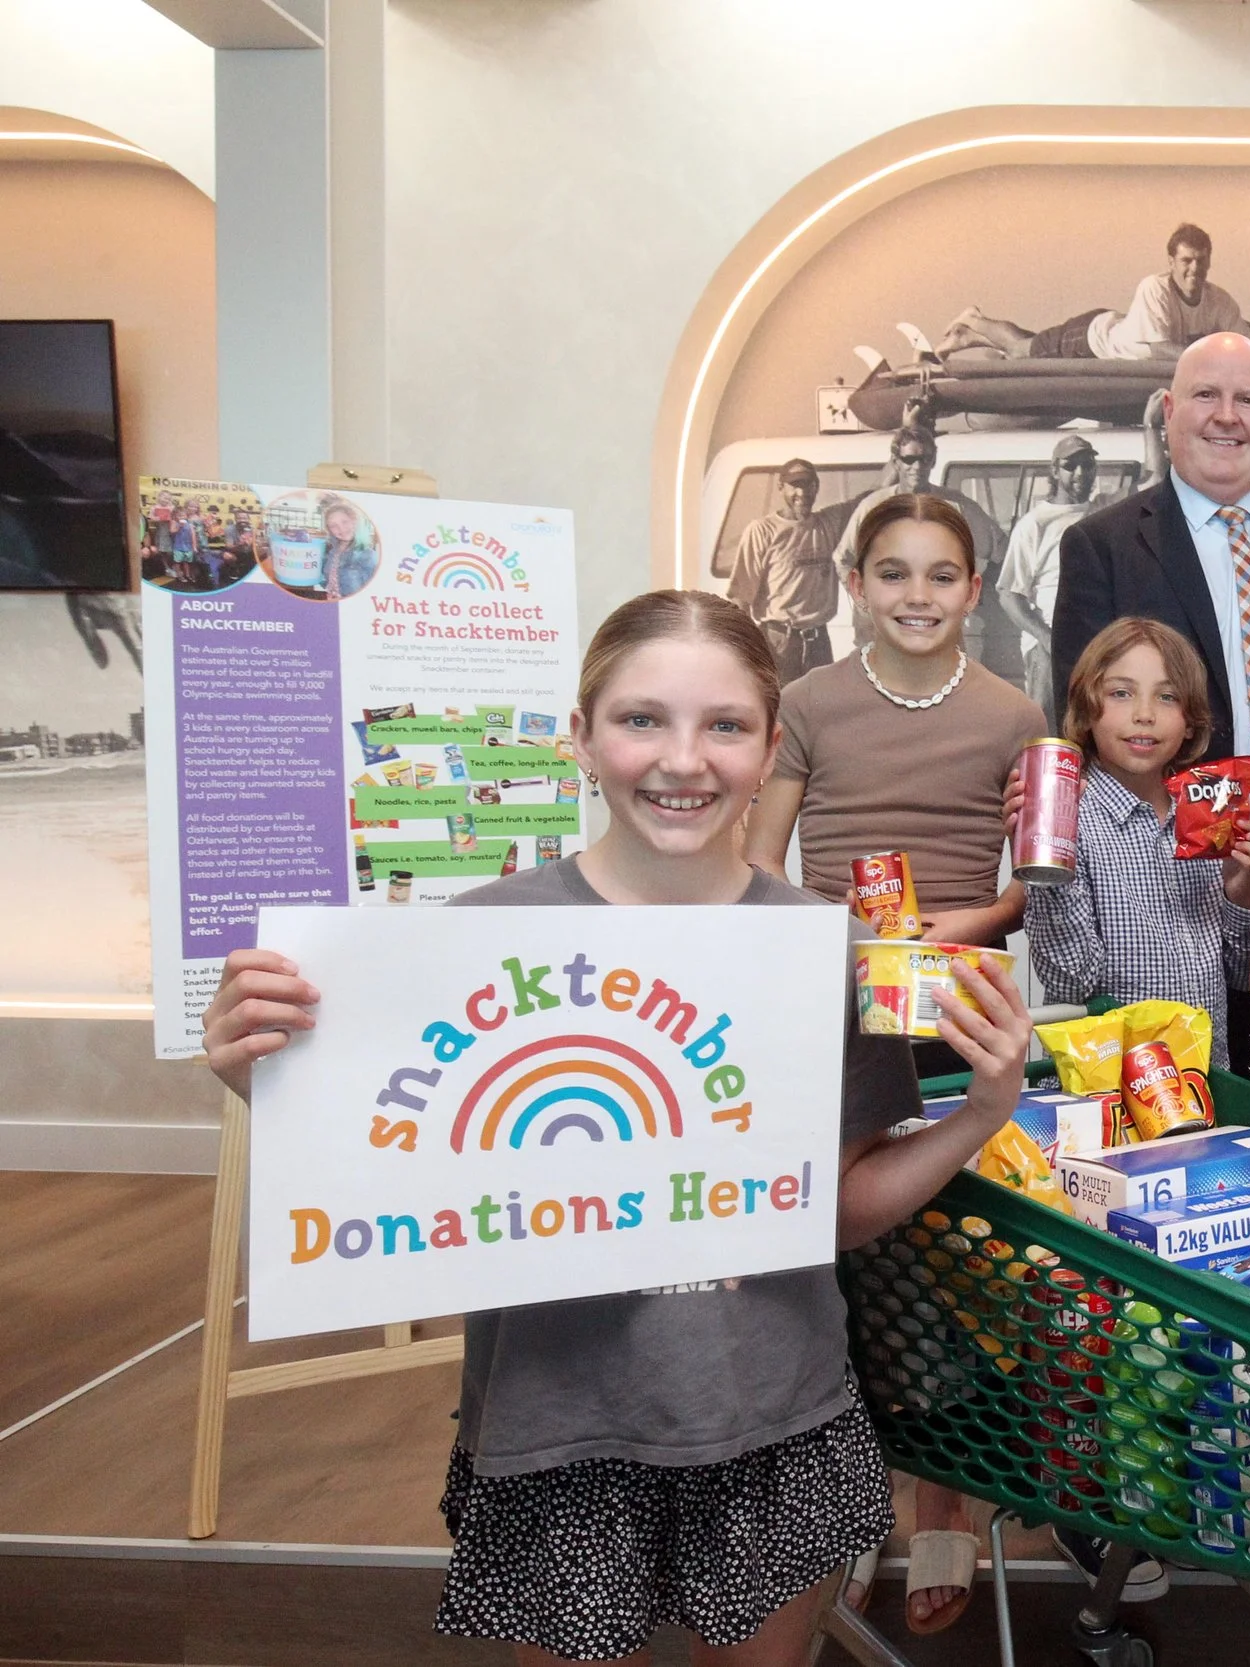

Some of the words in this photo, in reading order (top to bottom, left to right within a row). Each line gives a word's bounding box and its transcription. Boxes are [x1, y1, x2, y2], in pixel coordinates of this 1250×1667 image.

[396, 525, 529, 592] snacktember
[181, 601, 234, 612] ABOUT
[371, 596, 429, 615] What
[439, 601, 461, 616] to
[469, 602, 543, 620] collect
[181, 618, 294, 632] SNACKTEMBER
[372, 619, 405, 636] for
[415, 621, 559, 642] Snacktember
[182, 645, 200, 653] The
[202, 645, 248, 654] Australian
[251, 647, 308, 656] Government
[371, 725, 409, 733] Crackers,
[412, 725, 437, 733] muesli
[462, 726, 482, 734] chips
[489, 759, 515, 767] coffee,
[1188, 780, 1242, 802] Doros
[186, 814, 199, 822] All
[202, 813, 224, 822] food
[227, 813, 273, 821] donations
[506, 815, 522, 823] fruit
[533, 816, 575, 824] vegetables
[186, 825, 238, 833] distributed
[241, 825, 252, 834] by
[273, 824, 304, 832] friends
[370, 856, 398, 864] Sauces
[416, 855, 448, 863] tomato,
[866, 866, 883, 877] spc
[188, 893, 208, 902] The
[210, 892, 232, 902] goal
[235, 892, 243, 900] is
[259, 891, 286, 899] make
[289, 890, 309, 898] sure
[312, 889, 331, 897] that
[857, 879, 902, 899] SPAGHETTI
[189, 905, 218, 914] every
[222, 904, 252, 912] Aussie
[228, 915, 256, 924] going
[190, 928, 222, 936] effort.
[368, 953, 752, 1153] snacktember
[1137, 1055, 1155, 1067] spc
[1130, 1066, 1178, 1095] SPAGHETTI
[1061, 1169, 1079, 1197] 16
[1083, 1175, 1111, 1193] MULTI
[1082, 1189, 1107, 1206] PACK
[1139, 1178, 1172, 1204] 16
[290, 1190, 645, 1264] Donations
[669, 1161, 811, 1222] Here!
[1166, 1229, 1208, 1255] 1.2kg
